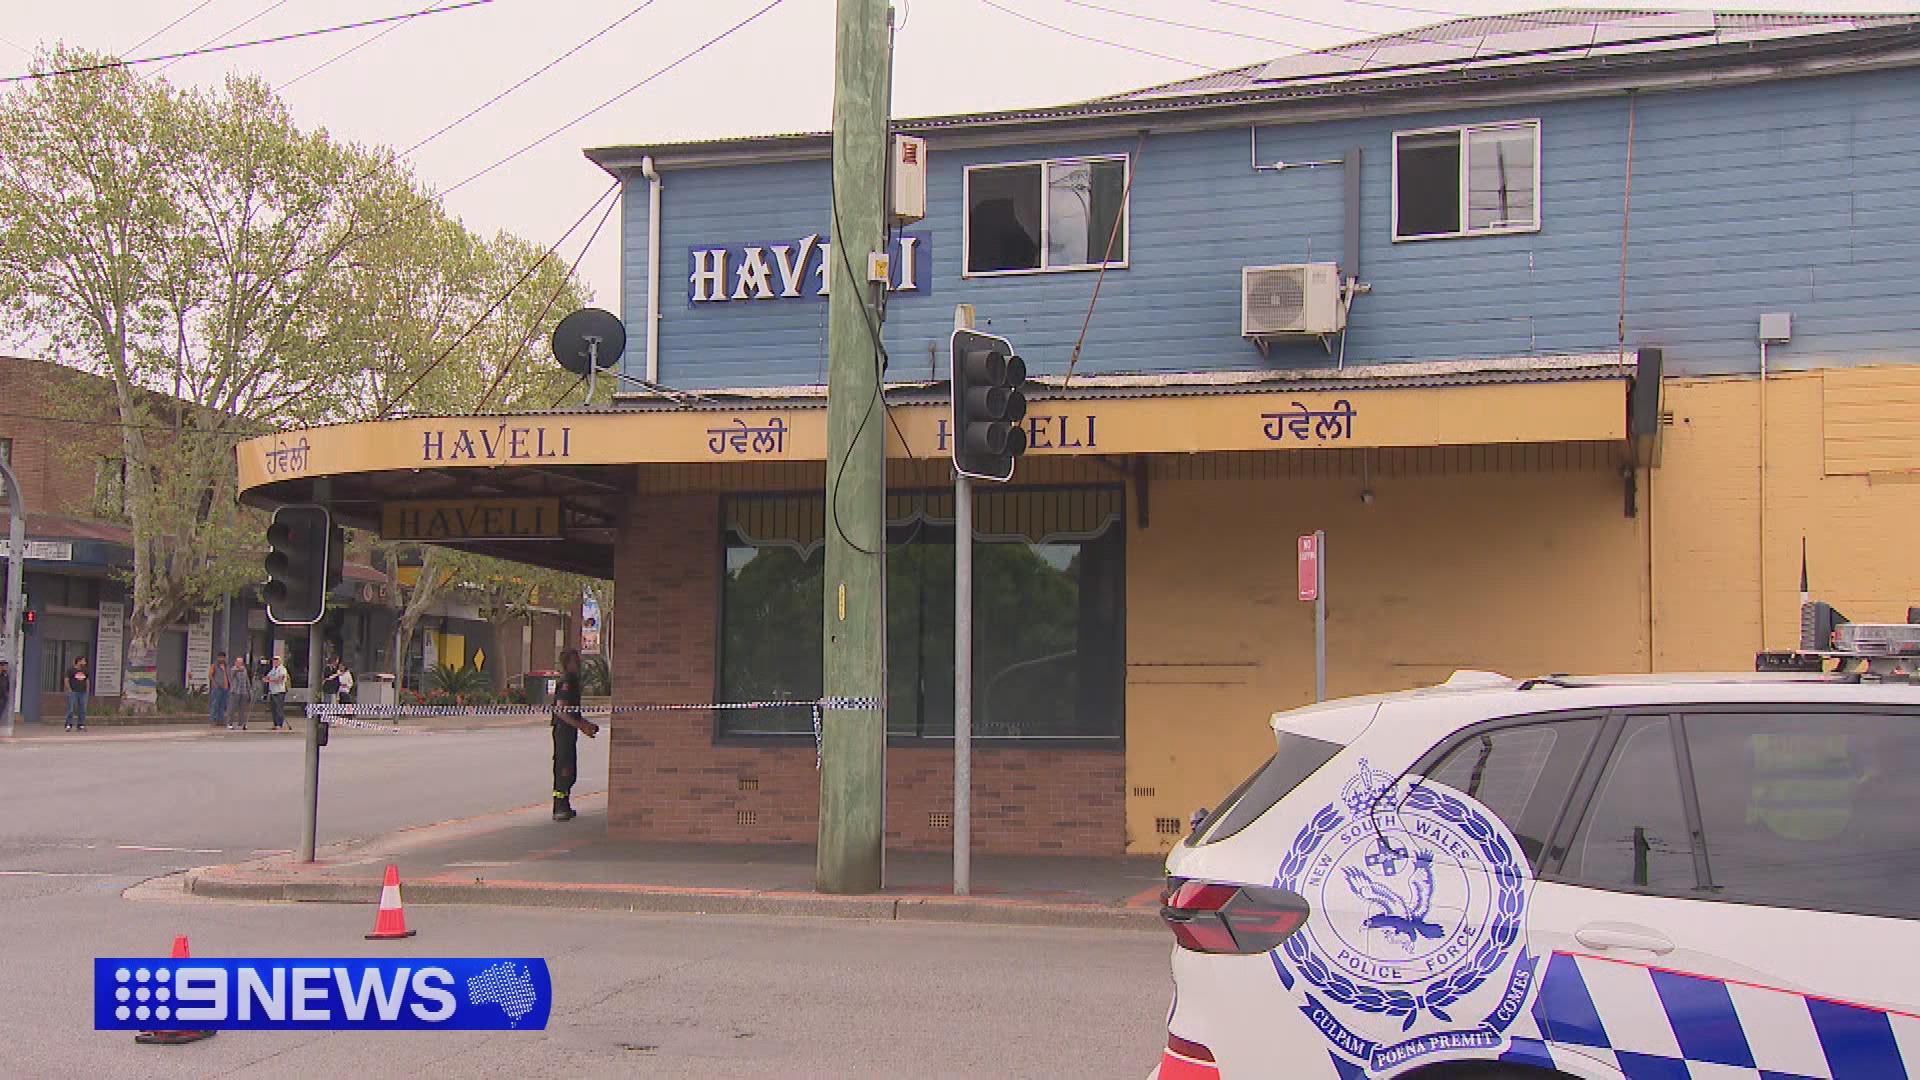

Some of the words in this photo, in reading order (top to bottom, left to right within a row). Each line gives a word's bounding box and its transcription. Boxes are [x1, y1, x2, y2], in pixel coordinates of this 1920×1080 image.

[690, 234, 918, 302] HAVI
[707, 417, 787, 454] ਹਵੇਲੀ
[937, 415, 1097, 450] HELI
[1261, 400, 1357, 441] ਹਵੇਲੀ
[265, 437, 310, 474] ਹਵੇਲੀ
[424, 423, 571, 461] HAVELI
[399, 504, 544, 537] HAVELI
[1308, 853, 1333, 887] NEW
[1341, 815, 1397, 845] SOUTH
[1415, 820, 1471, 860] WALES
[1337, 949, 1403, 979] POLICE
[1426, 925, 1477, 972] FORCE
[1312, 1008, 1366, 1056] CULPAM
[1377, 1041, 1426, 1069] POENA
[1430, 1031, 1493, 1055] PREMIT
[1497, 968, 1530, 1021] COMES
